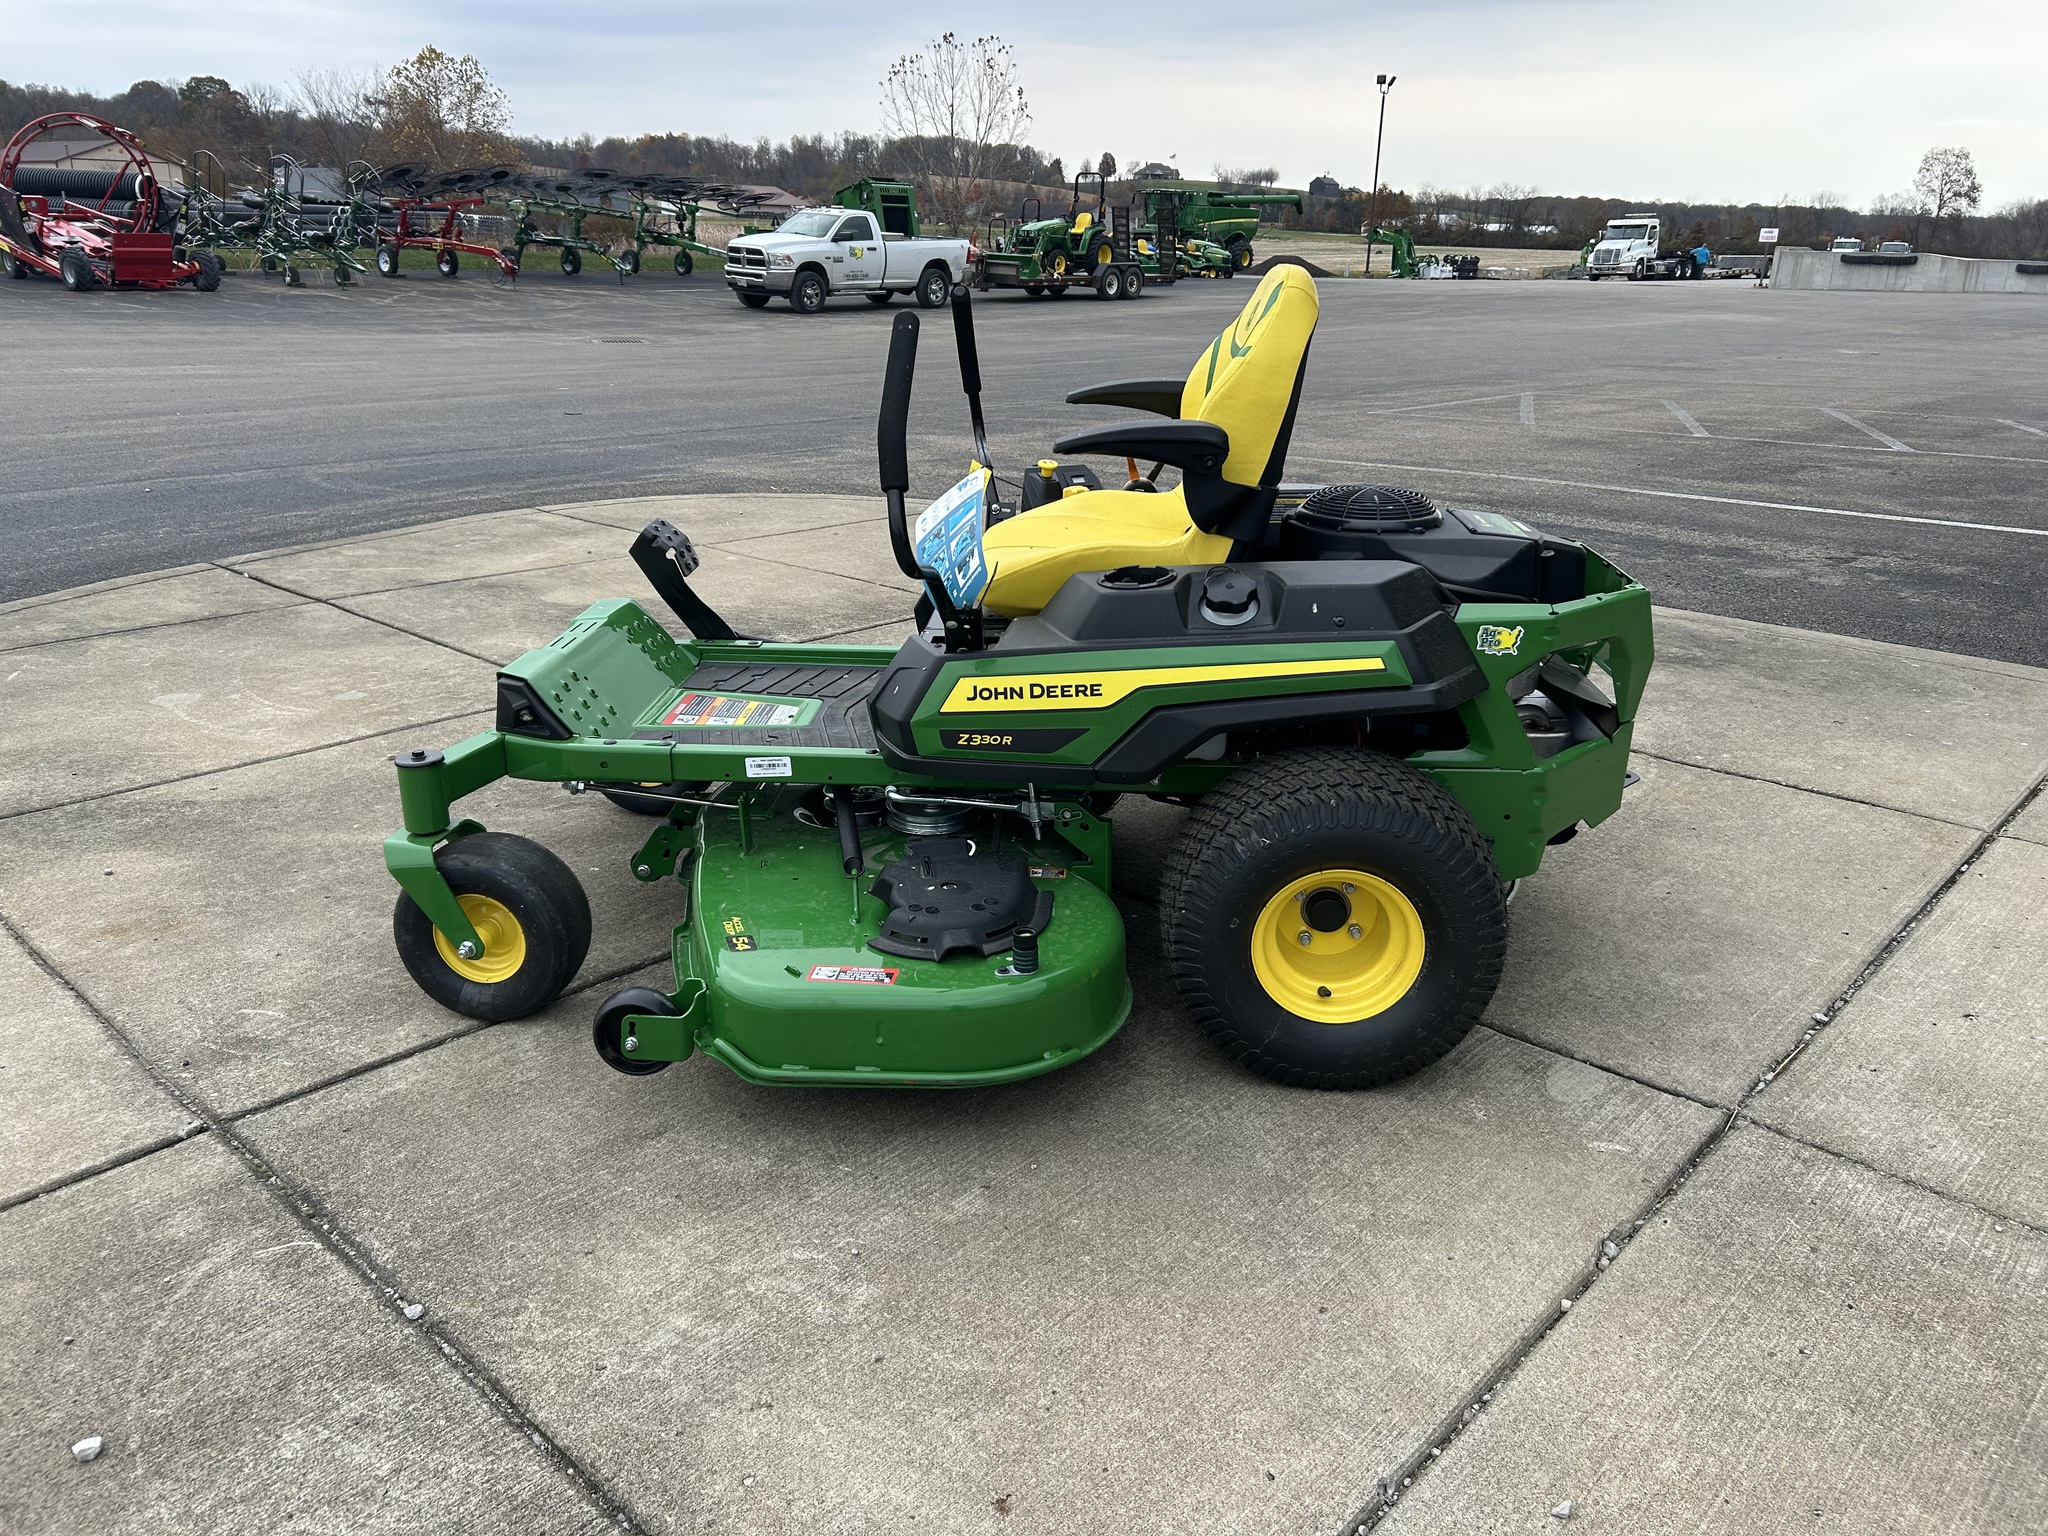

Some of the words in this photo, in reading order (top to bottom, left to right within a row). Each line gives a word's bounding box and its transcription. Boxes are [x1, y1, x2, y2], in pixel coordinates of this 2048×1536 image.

[1479, 637, 1501, 648] Pro
[966, 685, 1024, 701] JOHN
[1029, 683, 1103, 699] DEERE
[1229, 842, 1316, 907] KENDA
[722, 921, 736, 936] DEEP
[730, 916, 745, 934] ACCEL
[732, 936, 752, 951] 54
